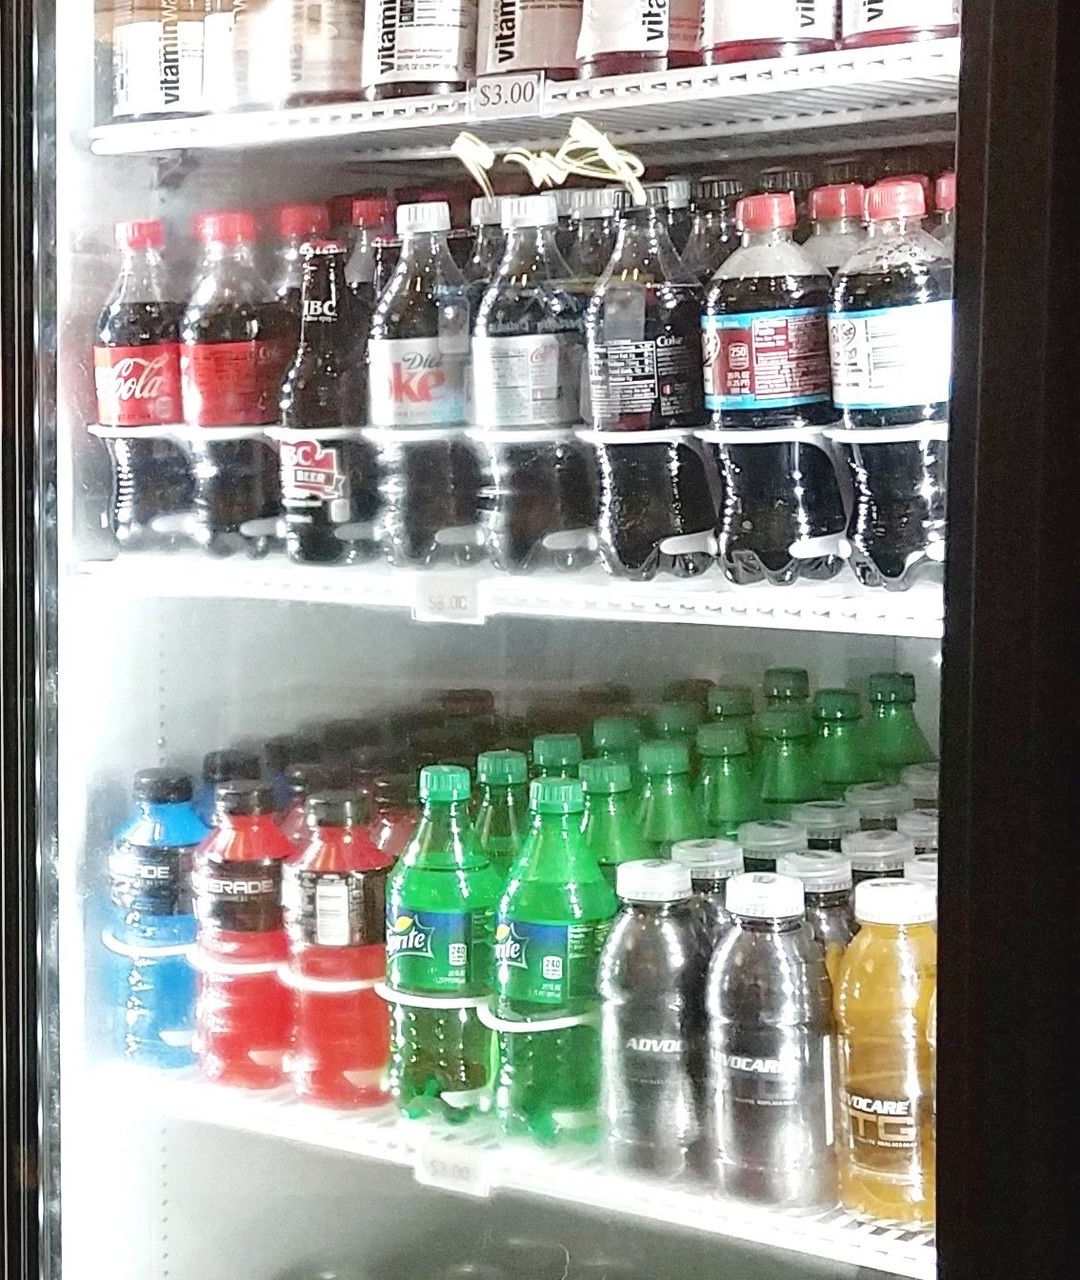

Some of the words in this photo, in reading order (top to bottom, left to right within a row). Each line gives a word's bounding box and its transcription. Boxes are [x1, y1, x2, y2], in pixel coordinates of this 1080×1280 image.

[479, 81, 535, 107] $3.00
[303, 299, 337, 317] IBC
[296, 470, 327, 483] BEER
